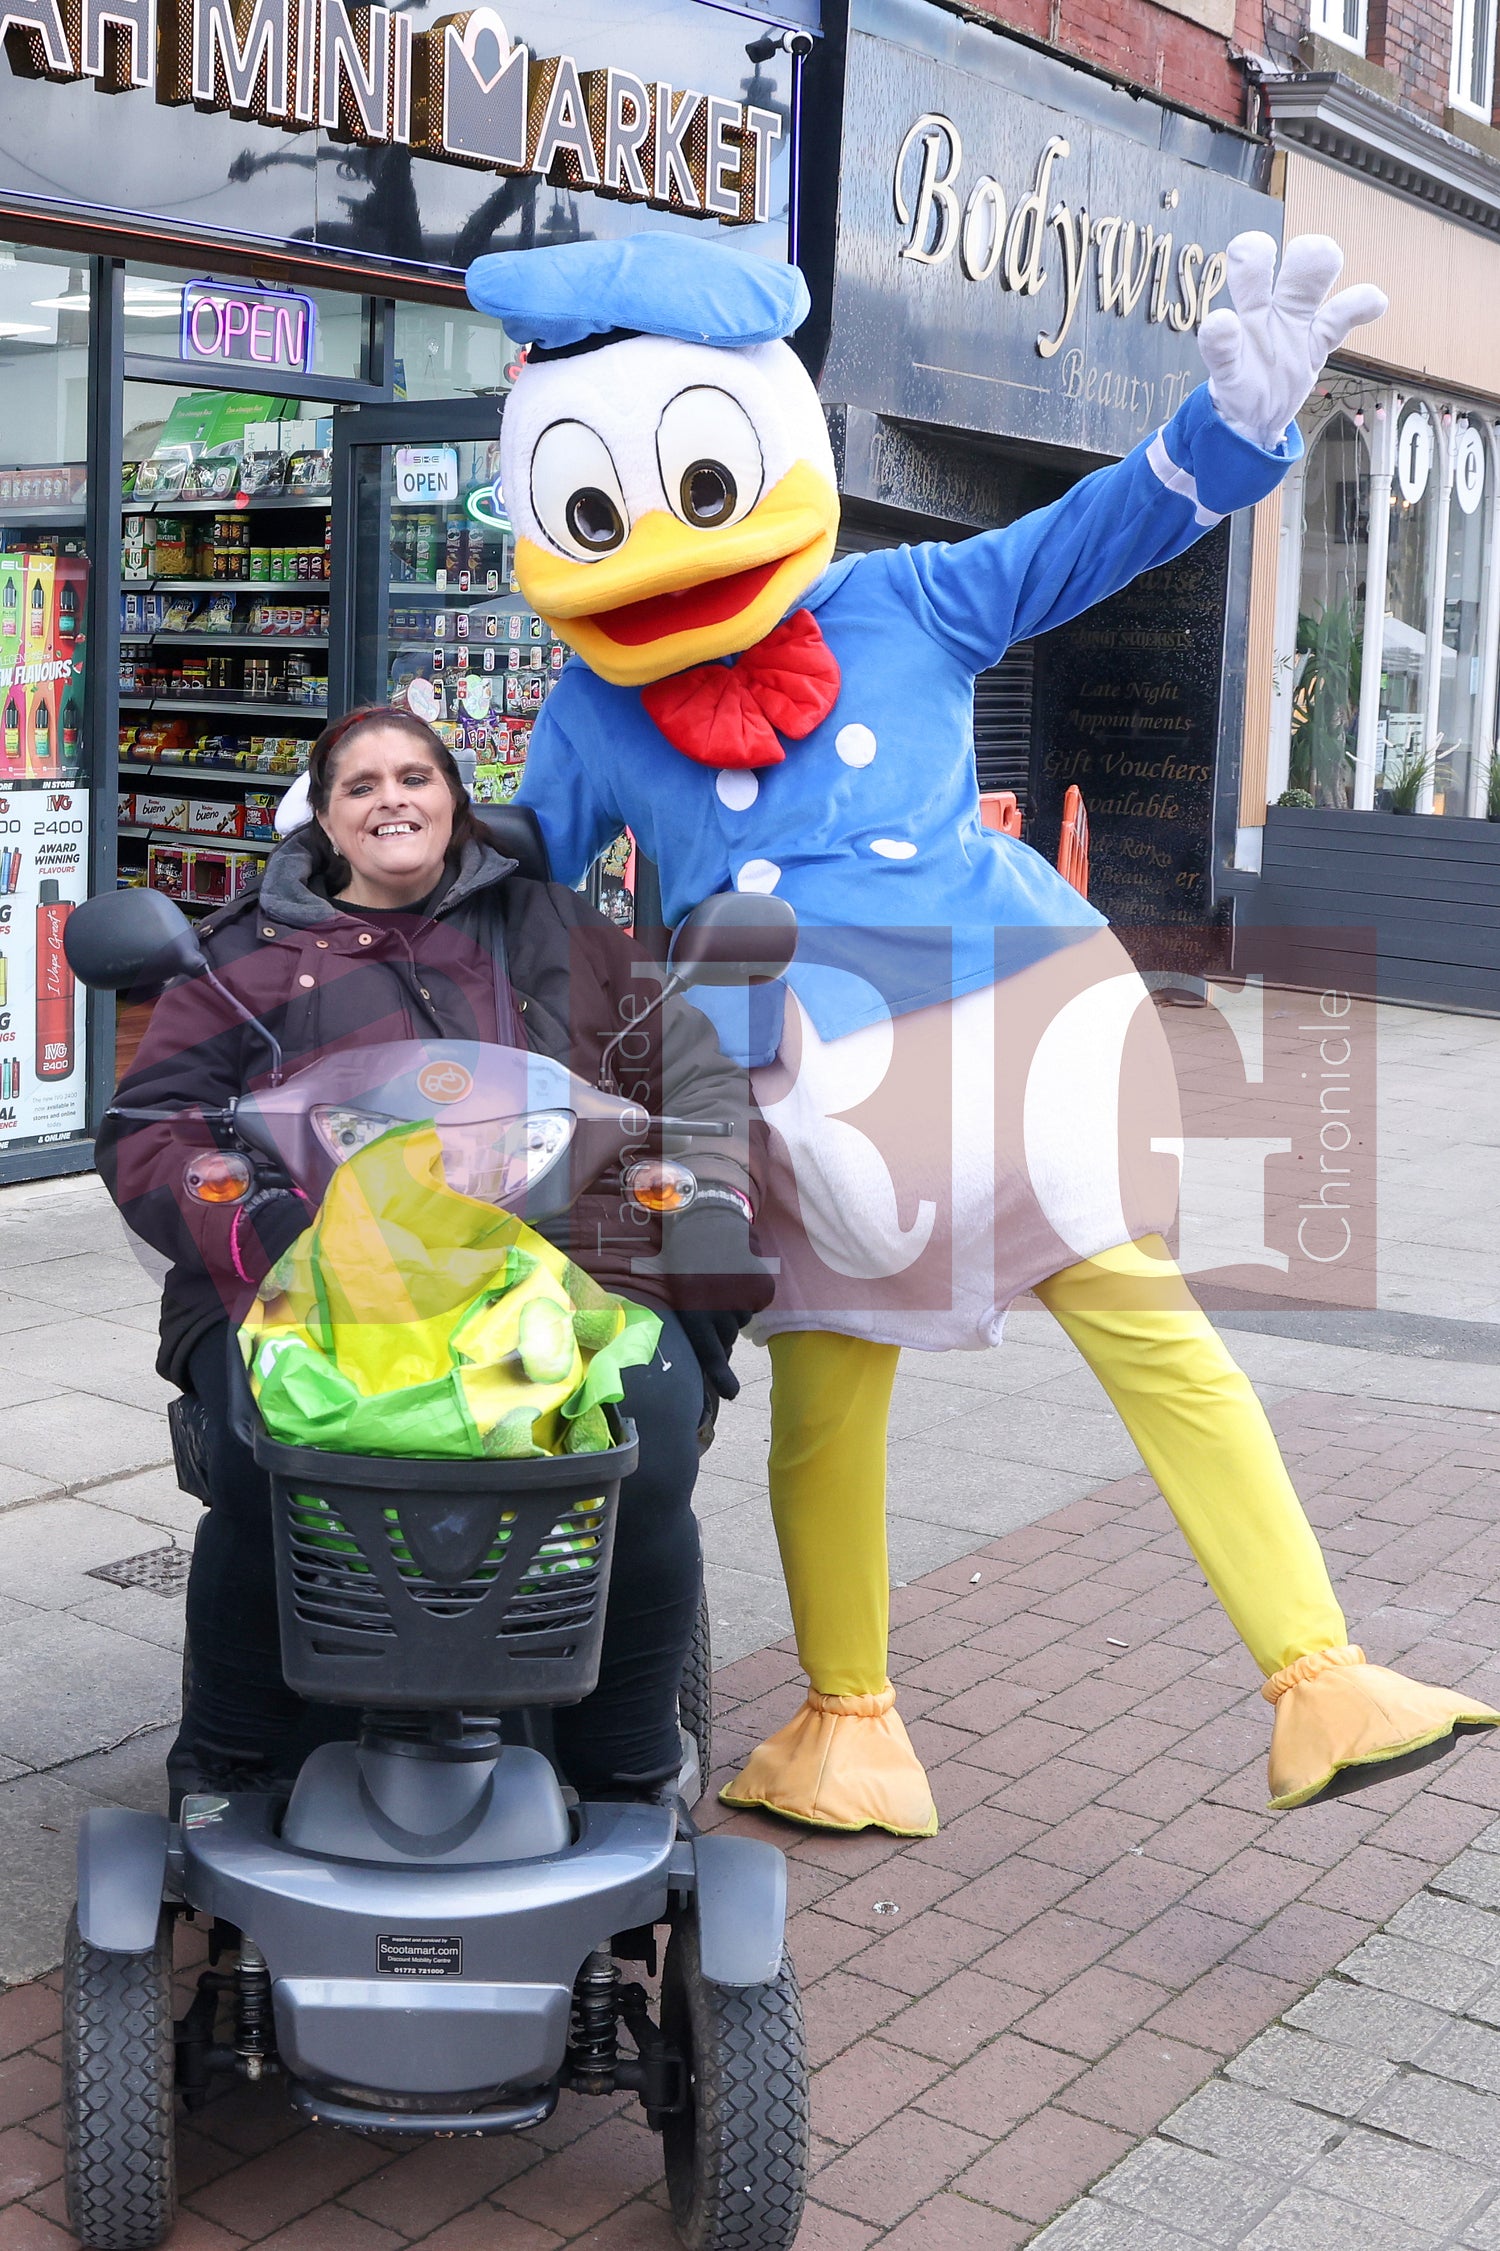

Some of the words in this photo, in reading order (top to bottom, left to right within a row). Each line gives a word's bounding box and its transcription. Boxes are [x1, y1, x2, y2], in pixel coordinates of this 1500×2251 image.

[190, 0, 413, 145] MINI
[894, 112, 1228, 358] Bodywise
[191, 296, 305, 366] OPEN
[1061, 347, 1156, 433] Beauty
[403, 472, 448, 493] OPEN
[1, 560, 54, 573] ELUX
[14, 659, 73, 686] FLAVOURS
[1080, 681, 1120, 698] Late
[1126, 681, 1181, 705] Night
[1067, 708, 1193, 736] Appointments
[1044, 748, 1092, 780] Gift
[1100, 751, 1211, 782] Vouchers
[43, 781, 52, 789] IN
[52, 780, 75, 789] STORE
[46, 794, 73, 812] IVG
[142, 803, 166, 815] bueno
[1087, 788, 1179, 820] vailable
[195, 810, 220, 821] bueno
[34, 820, 83, 835] 2400
[38, 843, 77, 854] AWARD
[35, 853, 80, 865] WINNING
[38, 866, 76, 874] FLAVOURS
[47, 954, 61, 984] Vape
[44, 1043, 67, 1060] IVG
[42, 1060, 69, 1071] 2400
[47, 1103, 69, 1111] available
[44, 1132, 71, 1142] ONLINE
[380, 1944, 459, 1956] Scootamart.com
[412, 1956, 432, 1964] Mobility
